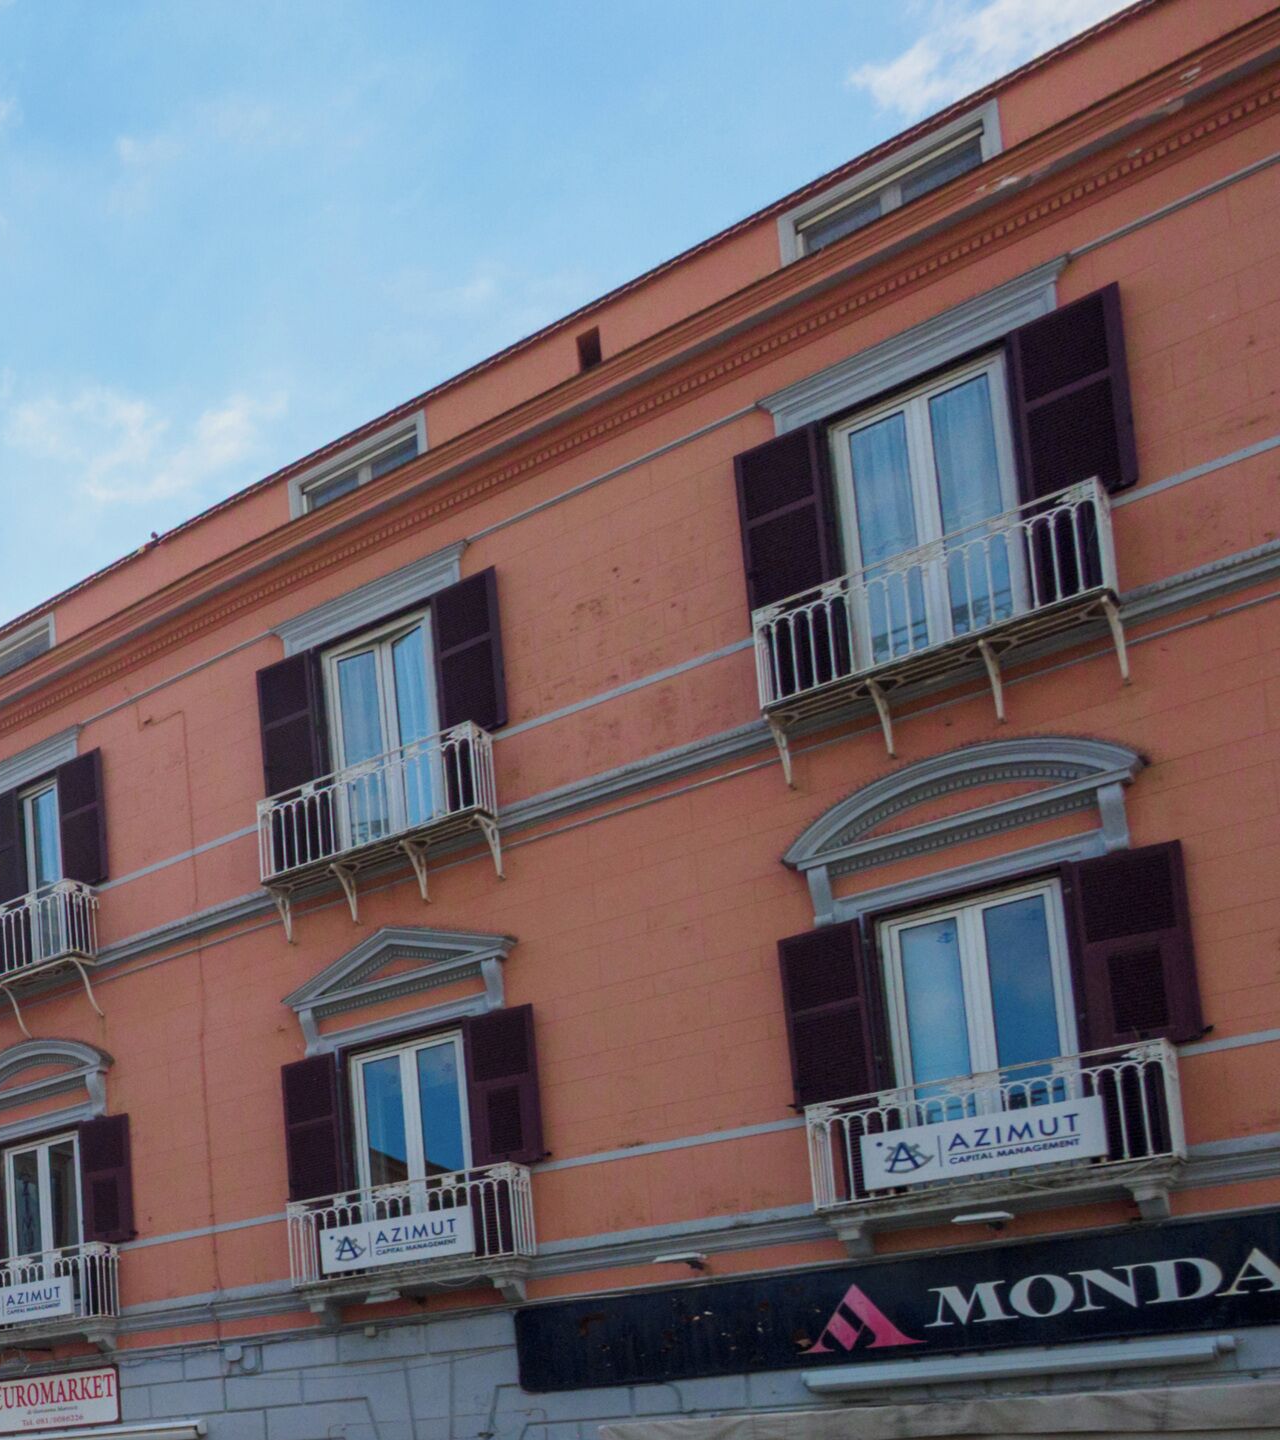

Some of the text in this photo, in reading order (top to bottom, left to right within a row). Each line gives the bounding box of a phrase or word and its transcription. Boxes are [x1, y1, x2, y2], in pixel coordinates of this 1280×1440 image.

[948, 1113, 1079, 1151] AZIMUT
[949, 1138, 1080, 1165] CAPITAL MANAGEMENT
[376, 1218, 456, 1244] AZIMUT
[376, 1238, 457, 1256] CAPITAL MANAGEMENT
[6, 1286, 61, 1307] AZIMUT
[924, 1247, 1280, 1328] MONDA
[7, 1302, 61, 1315] CAPITAL MANAGEMENT
